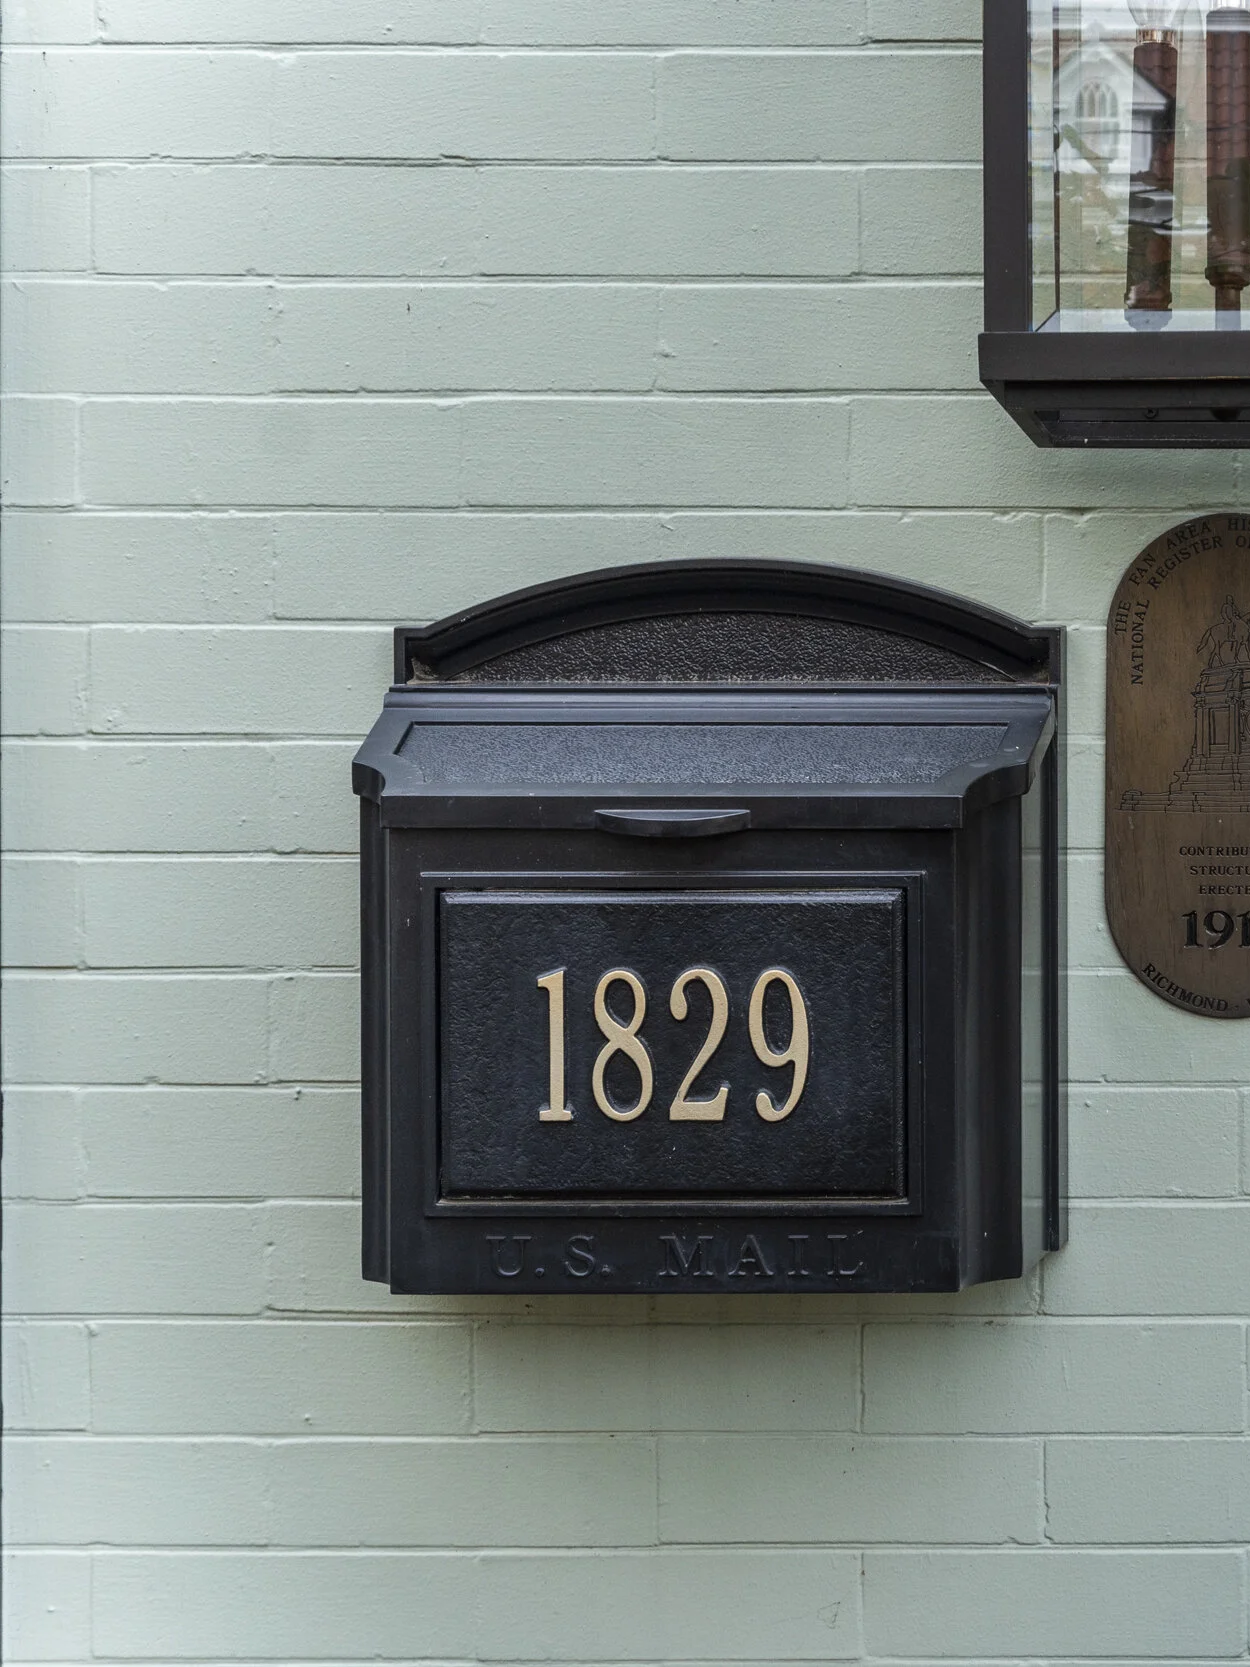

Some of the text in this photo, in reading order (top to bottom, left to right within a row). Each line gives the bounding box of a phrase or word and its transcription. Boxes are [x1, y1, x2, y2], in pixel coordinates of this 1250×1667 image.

[1114, 600, 1132, 635] THE
[1129, 553, 1157, 587] FAN
[1166, 519, 1212, 550] AREA
[1131, 599, 1150, 685] NATIONAL
[1146, 535, 1223, 590] REGISTER
[537, 967, 810, 1122] 1829
[1141, 962, 1229, 1012] RICHMOND
[658, 1233, 864, 1277] MAIL
